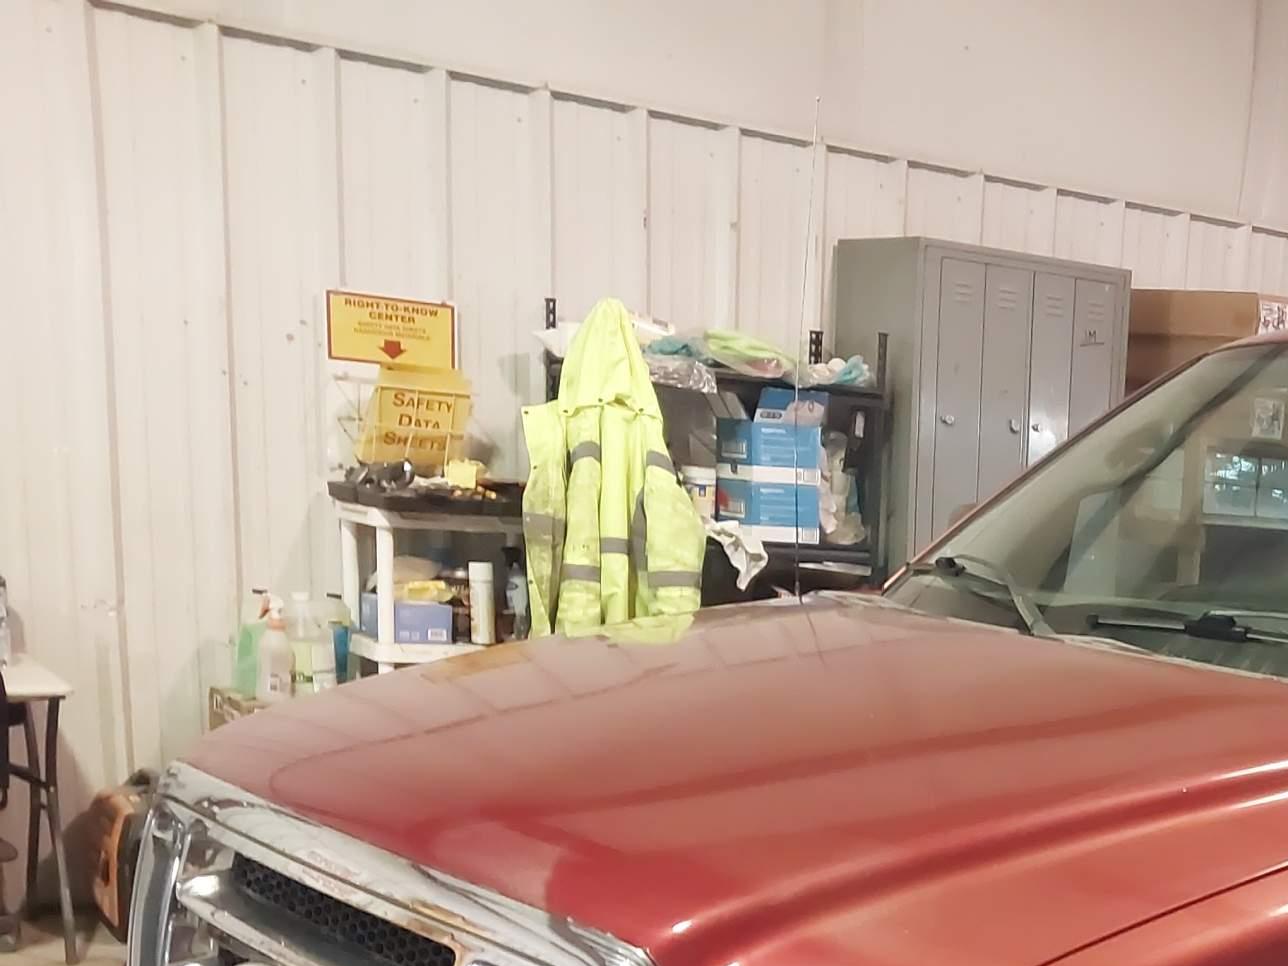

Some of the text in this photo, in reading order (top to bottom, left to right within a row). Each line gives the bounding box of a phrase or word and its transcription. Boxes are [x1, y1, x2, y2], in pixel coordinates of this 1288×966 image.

[368, 311, 416, 325] CENTER
[392, 391, 453, 414] SAFETY
[398, 413, 441, 430] DATA
